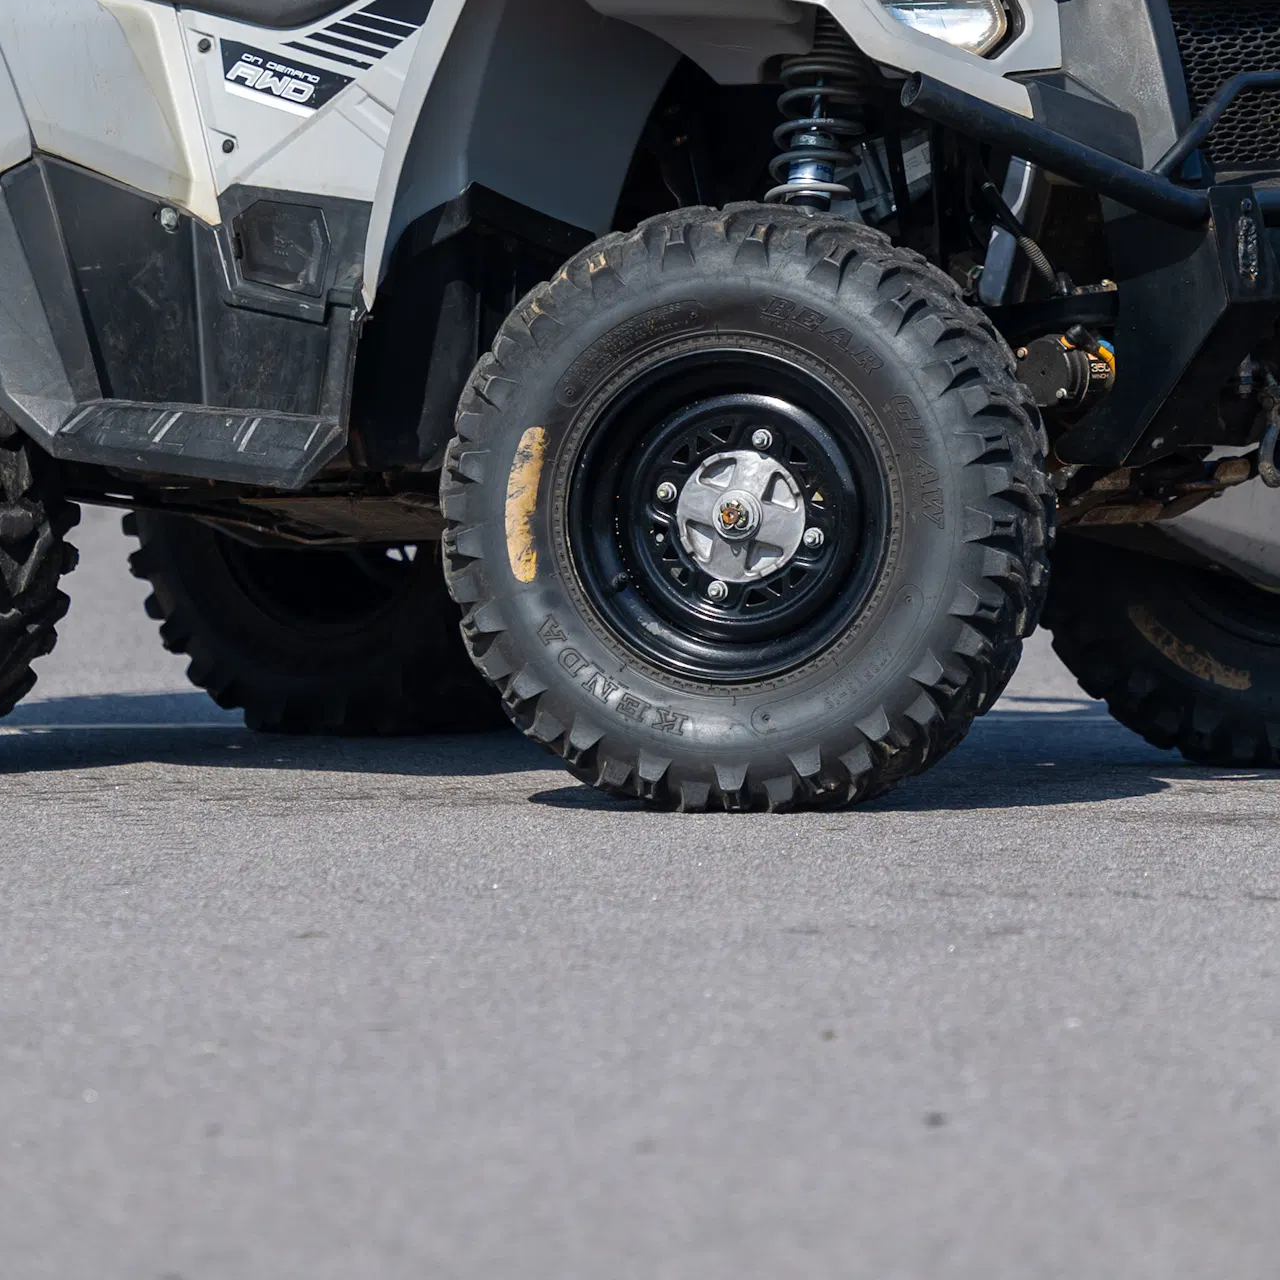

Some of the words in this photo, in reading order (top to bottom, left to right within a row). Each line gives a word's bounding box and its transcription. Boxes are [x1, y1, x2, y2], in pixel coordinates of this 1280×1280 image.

[226, 60, 315, 103] AWD
[241, 53, 263, 65] ON
[266, 61, 320, 83] DEMAND
[762, 295, 885, 375] BEAR
[891, 393, 945, 529] CLAW
[536, 613, 689, 736] KENDA
